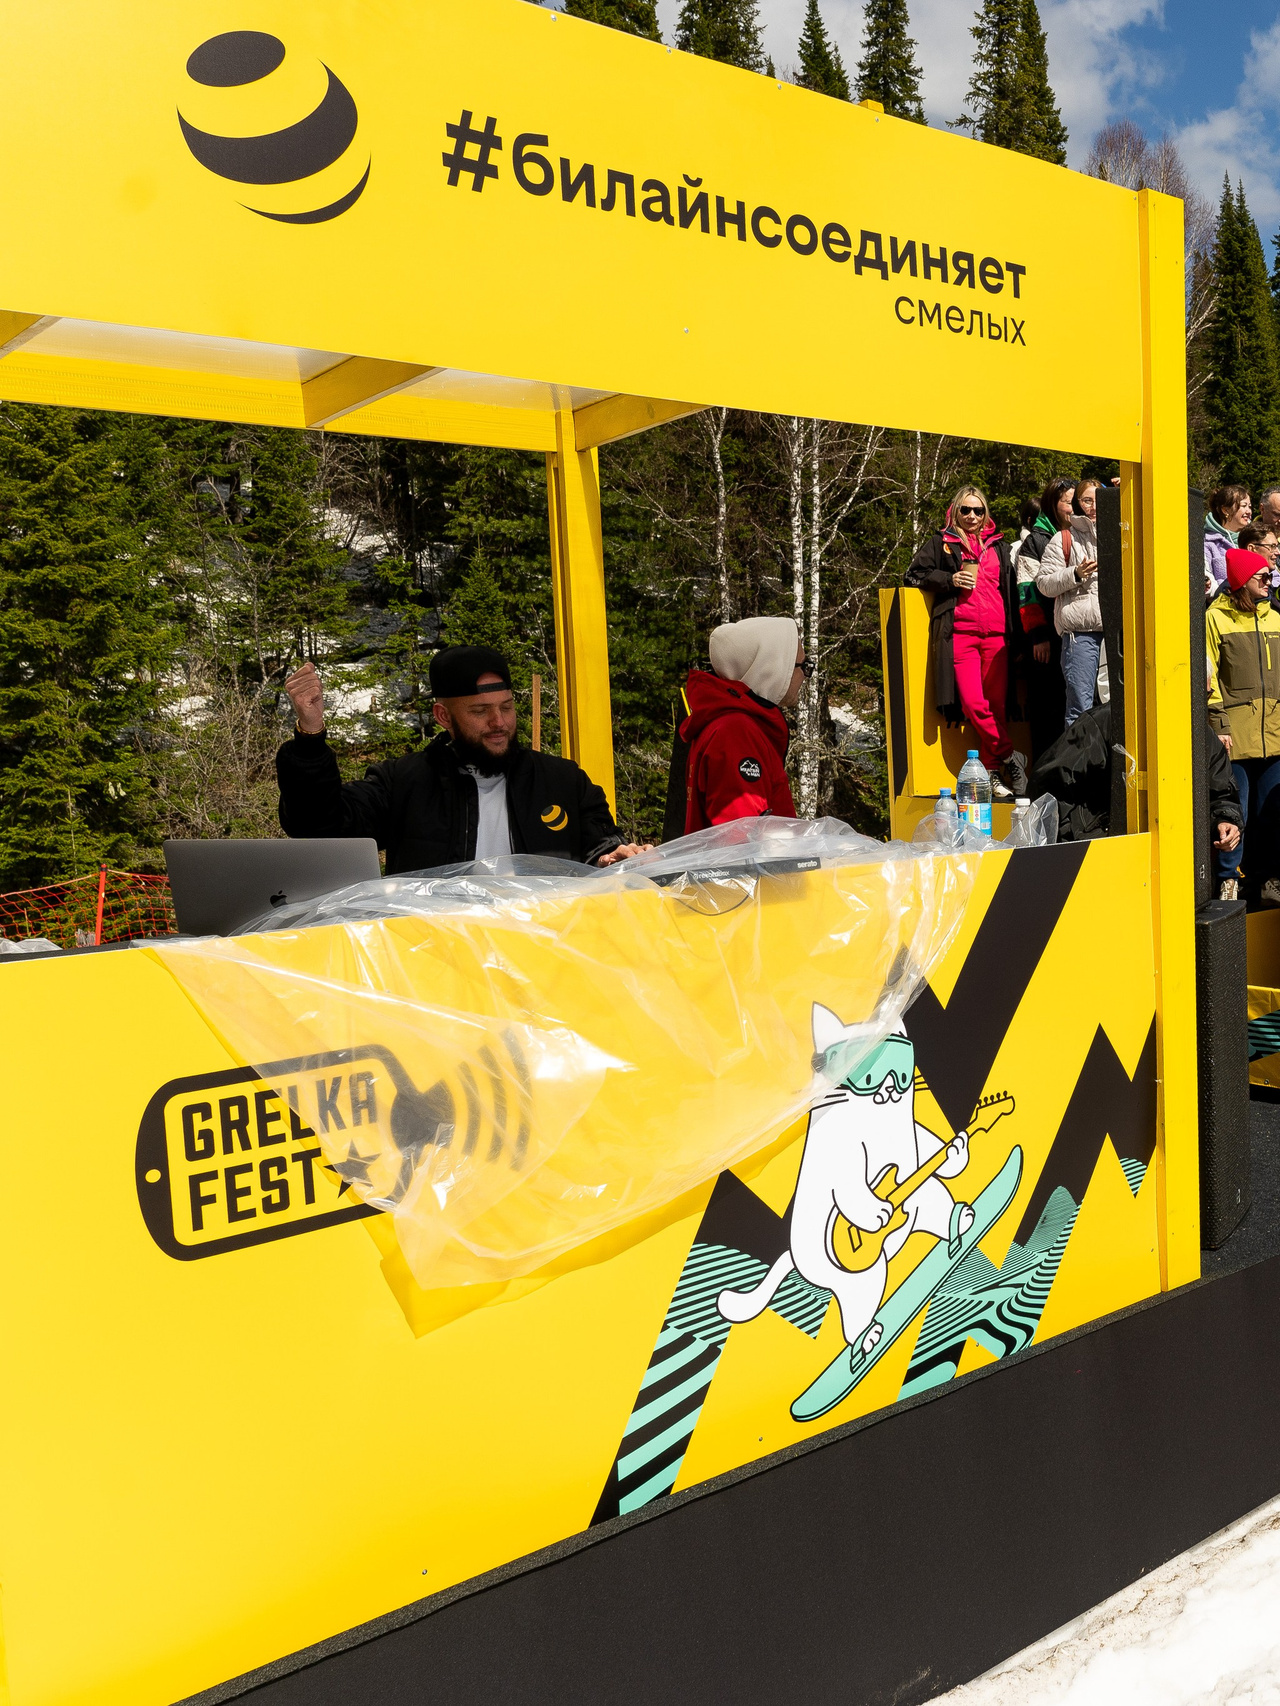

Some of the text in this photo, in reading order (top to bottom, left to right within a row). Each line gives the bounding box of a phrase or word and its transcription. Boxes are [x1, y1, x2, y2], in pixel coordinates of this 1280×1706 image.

[442, 110, 1026, 299] #билайнсоединяет
[894, 297, 1026, 346] смелых
[797, 860, 818, 869] serato
[181, 1071, 378, 1162] GRELKA
[188, 1147, 322, 1232] FEST
